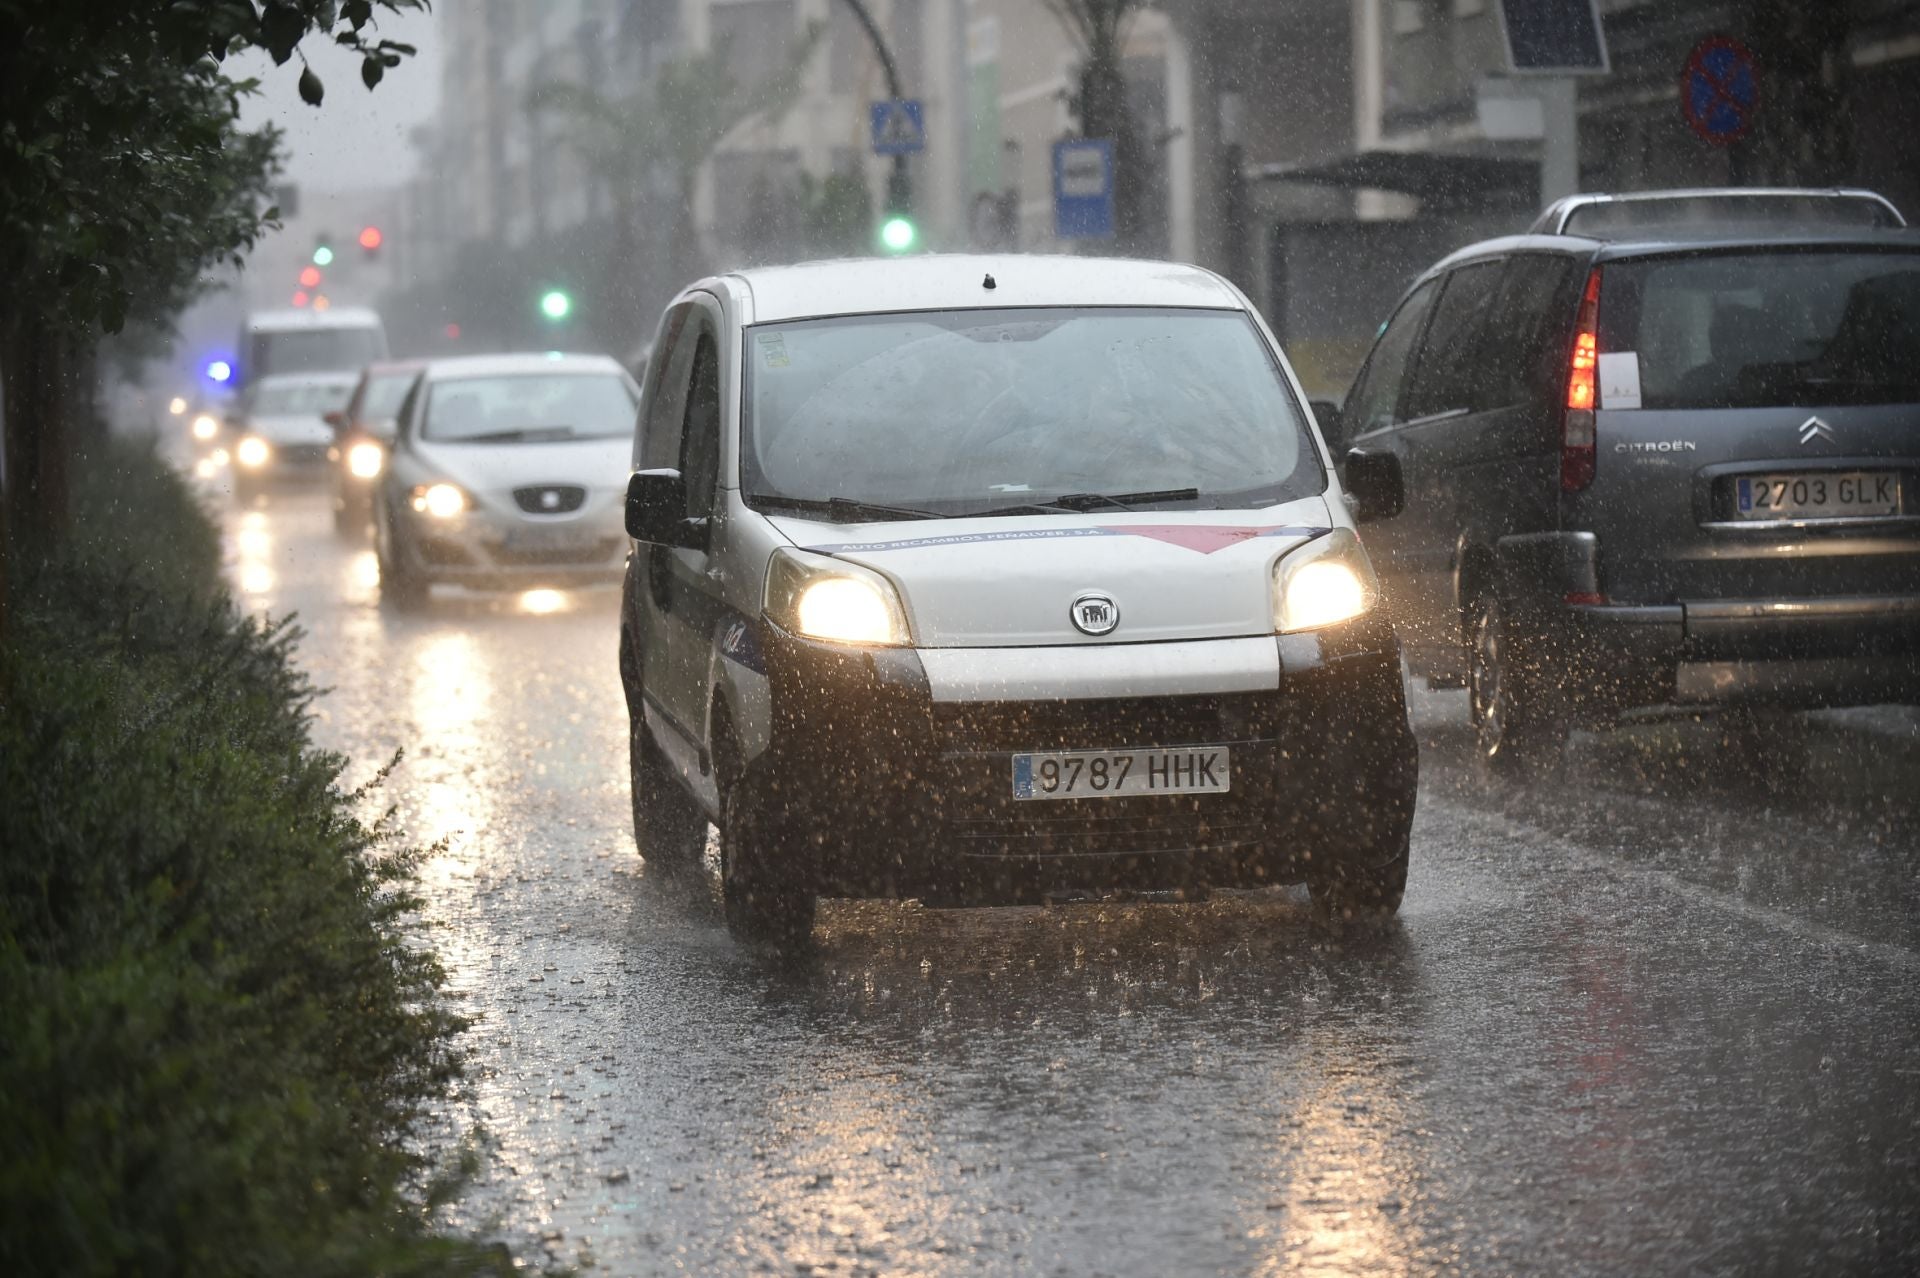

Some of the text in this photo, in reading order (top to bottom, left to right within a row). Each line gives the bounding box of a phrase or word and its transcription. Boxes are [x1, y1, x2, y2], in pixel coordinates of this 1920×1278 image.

[1614, 440, 1696, 453] CITROËN
[1755, 477, 1891, 508] 2703 GLK
[891, 534, 982, 548] RECAMBIOS
[1019, 753, 1219, 793] E 9787 HHK
